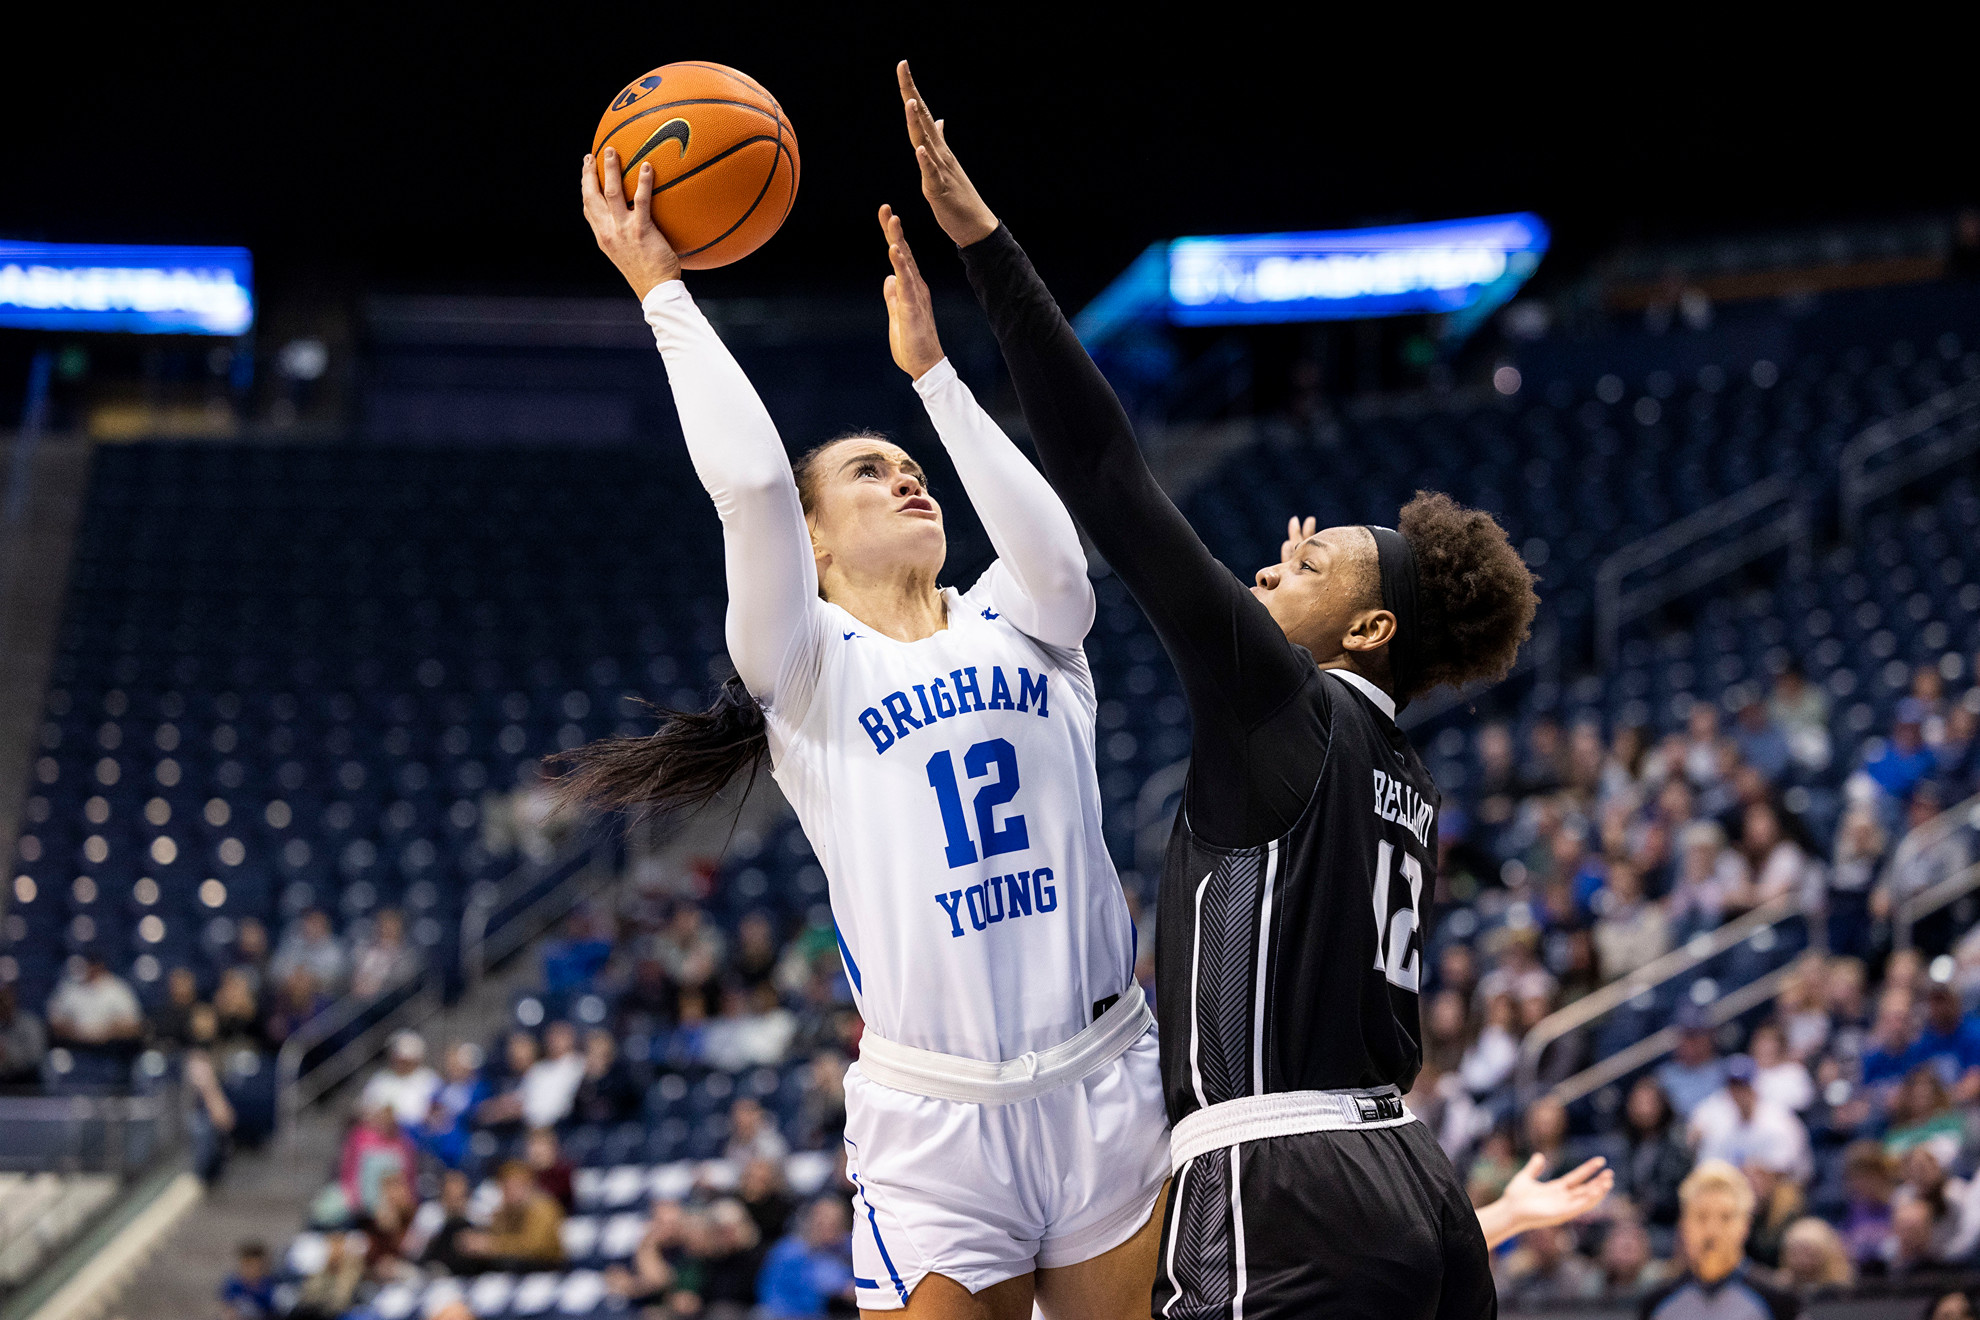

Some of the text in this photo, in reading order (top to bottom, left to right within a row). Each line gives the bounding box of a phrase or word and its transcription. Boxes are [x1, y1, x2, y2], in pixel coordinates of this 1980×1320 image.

[858, 666, 1048, 755] BRIGHAM
[926, 738, 1030, 869] 12
[934, 866, 1058, 938] YOUNG
[1372, 838, 1423, 994] 12
